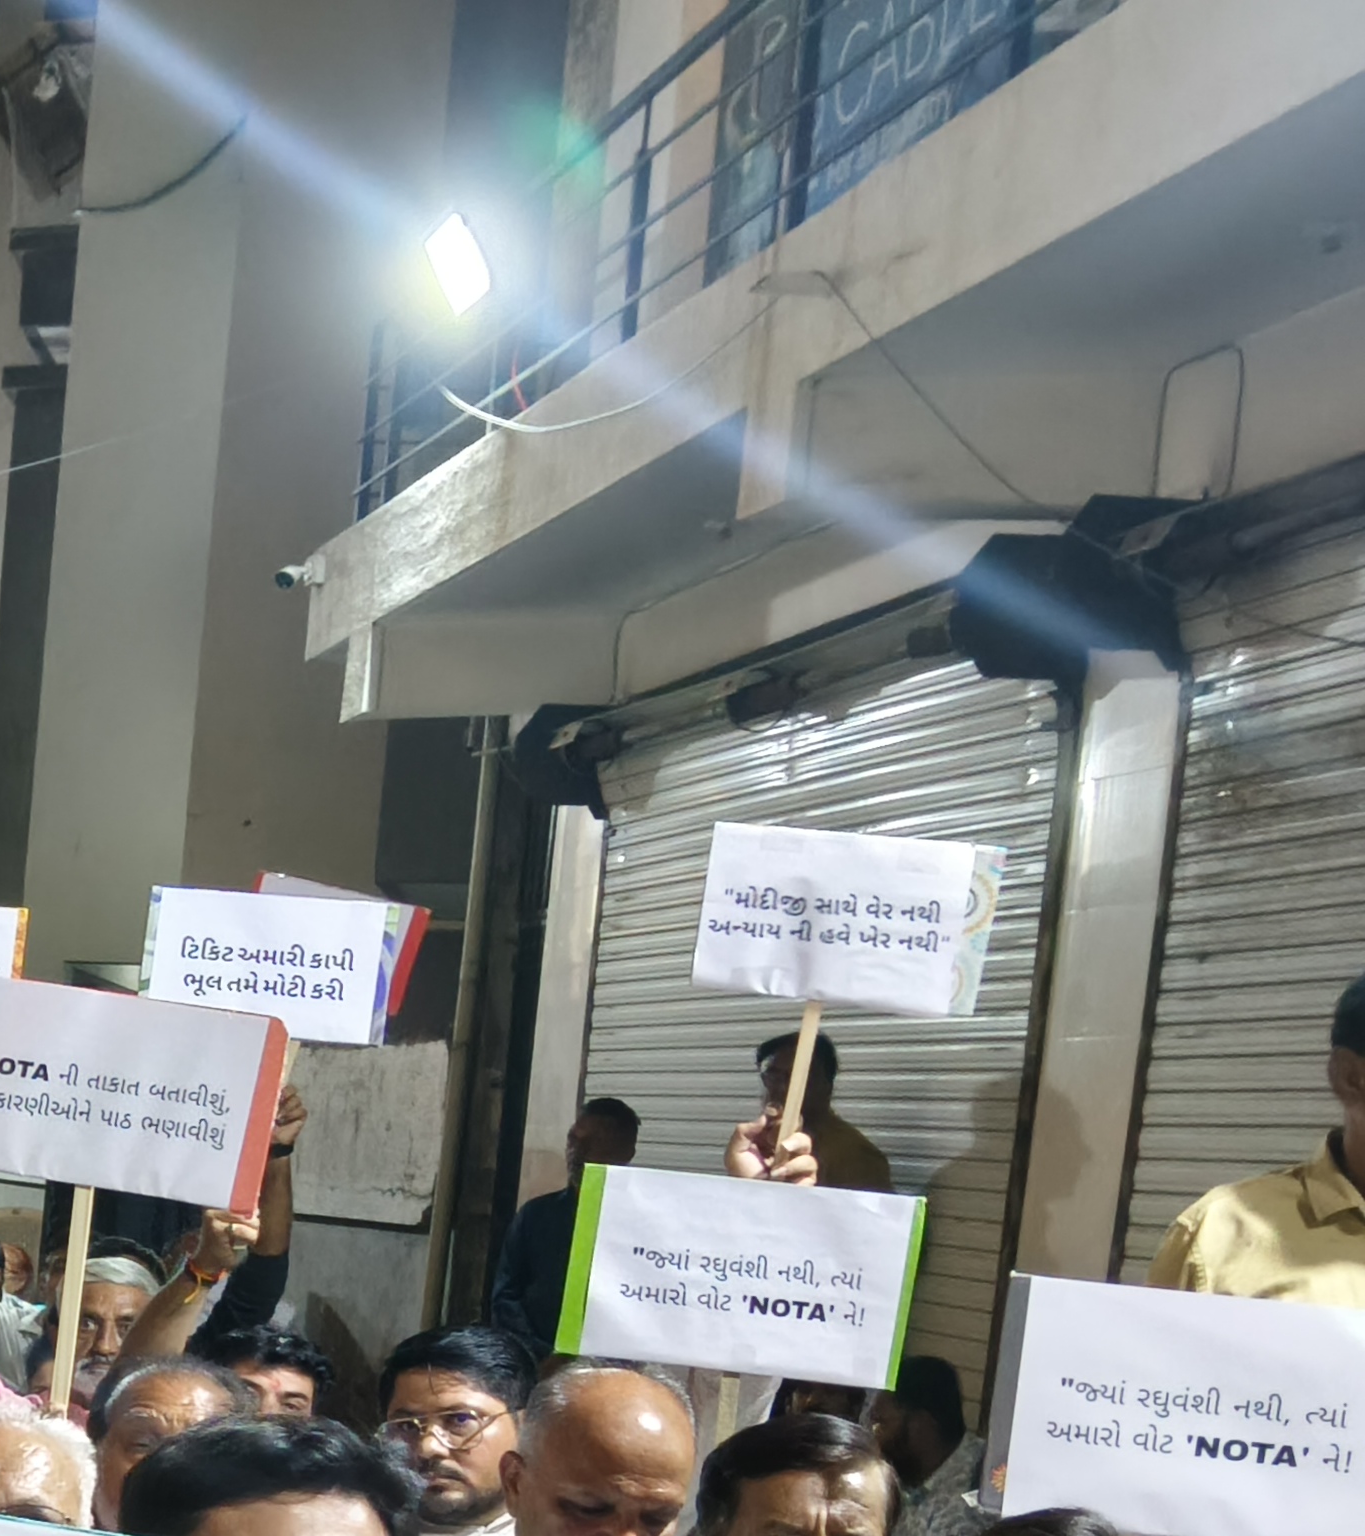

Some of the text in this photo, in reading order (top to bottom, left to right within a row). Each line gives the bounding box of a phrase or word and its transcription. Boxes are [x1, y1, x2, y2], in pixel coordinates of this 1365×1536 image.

[725, 885, 941, 924] "મોદીજી સાથે વેર નથી
[181, 935, 354, 971] ટિકિટ અમારી કાપી
[708, 919, 950, 953] અન્યાય ની હવે ખેર નથી"
[183, 971, 344, 1001] ભૂલ તમે મોટી કરી
[59, 1063, 79, 1087] ની
[87, 1075, 140, 1096] તાકાત
[101, 1109, 132, 1129] પાઠ
[633, 1247, 861, 1290] "જ્યાં રઘુવંશી નથી, ત્યાં
[620, 1282, 865, 1326] અમારો વોટ 'NOTA' ને!
[1061, 1377, 1346, 1428] "જ્યાં રઘુવંશી નથી, ત્યાં
[1047, 1420, 1352, 1473] અમારો વોટ 'NOTA' ને!
